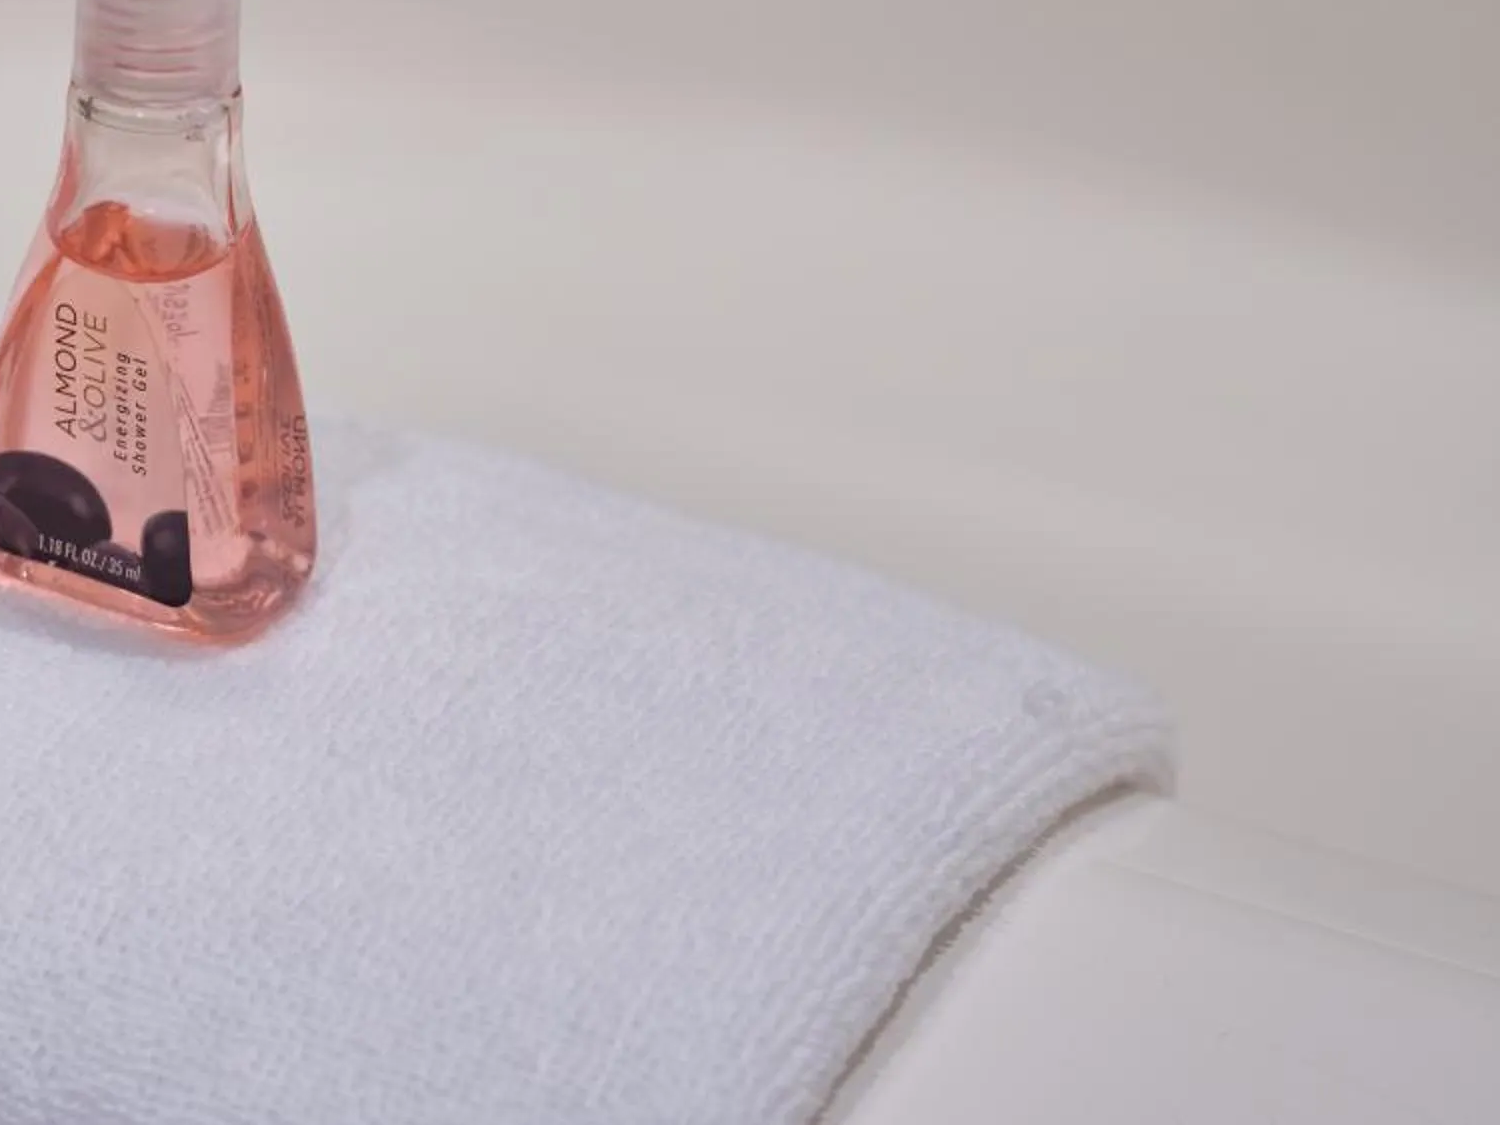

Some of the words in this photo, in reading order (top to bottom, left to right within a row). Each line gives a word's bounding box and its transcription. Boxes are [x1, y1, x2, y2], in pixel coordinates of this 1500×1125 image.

[54, 302, 77, 440] ALMOND
[77, 311, 108, 443] &OLIVE
[113, 352, 131, 461] Energizing
[132, 357, 148, 392] Gel
[132, 401, 148, 477] Shower
